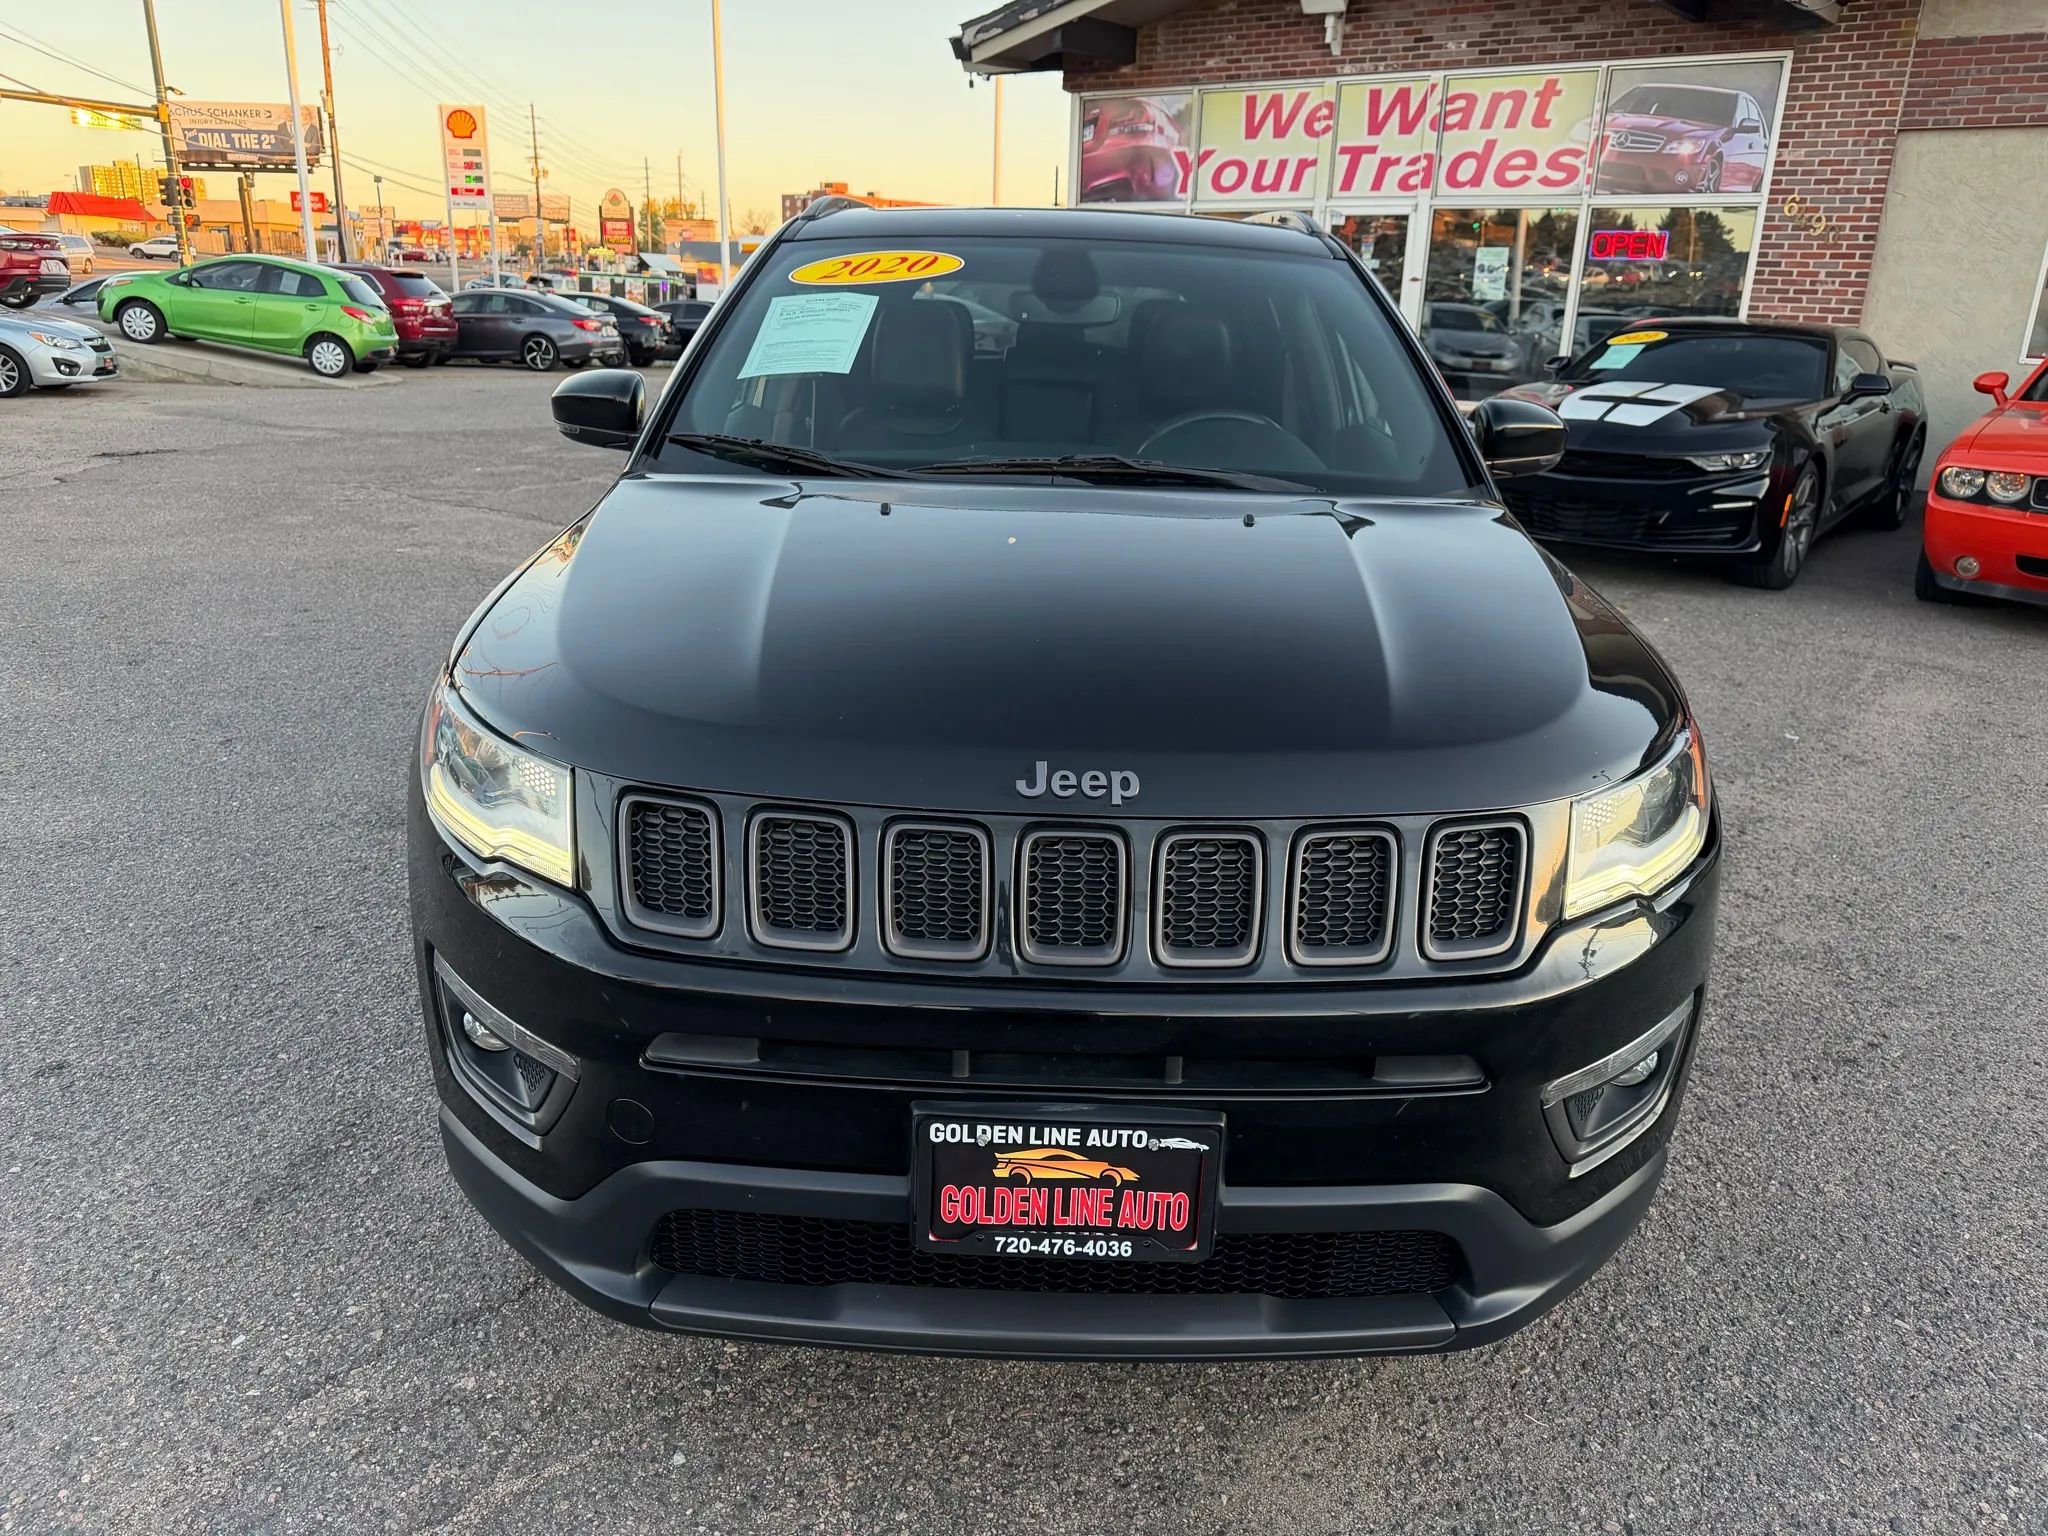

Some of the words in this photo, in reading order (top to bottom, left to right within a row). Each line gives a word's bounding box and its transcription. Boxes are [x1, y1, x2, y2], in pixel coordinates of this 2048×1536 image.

[169, 107, 203, 117] ACHUS
[206, 108, 262, 119] SCHANKER
[1245, 91, 1335, 140] We
[1366, 77, 1563, 137] Want
[198, 132, 231, 149] DIAL
[231, 133, 260, 150] THE
[1174, 149, 1318, 195] Your
[1338, 133, 1610, 193] Trades!
[1591, 231, 1667, 259] OPEN
[816, 254, 939, 281] 2020
[1015, 760, 1140, 807] Jeep
[929, 1122, 1023, 1145] GOLDEN
[1029, 1126, 1081, 1147] LINE
[1086, 1128, 1149, 1149] AUTO
[940, 1184, 1048, 1226] GOLDEN
[1053, 1186, 1114, 1227] LINE
[1117, 1189, 1190, 1232] AUTO
[994, 1236, 1133, 1258] 720-476-4036
